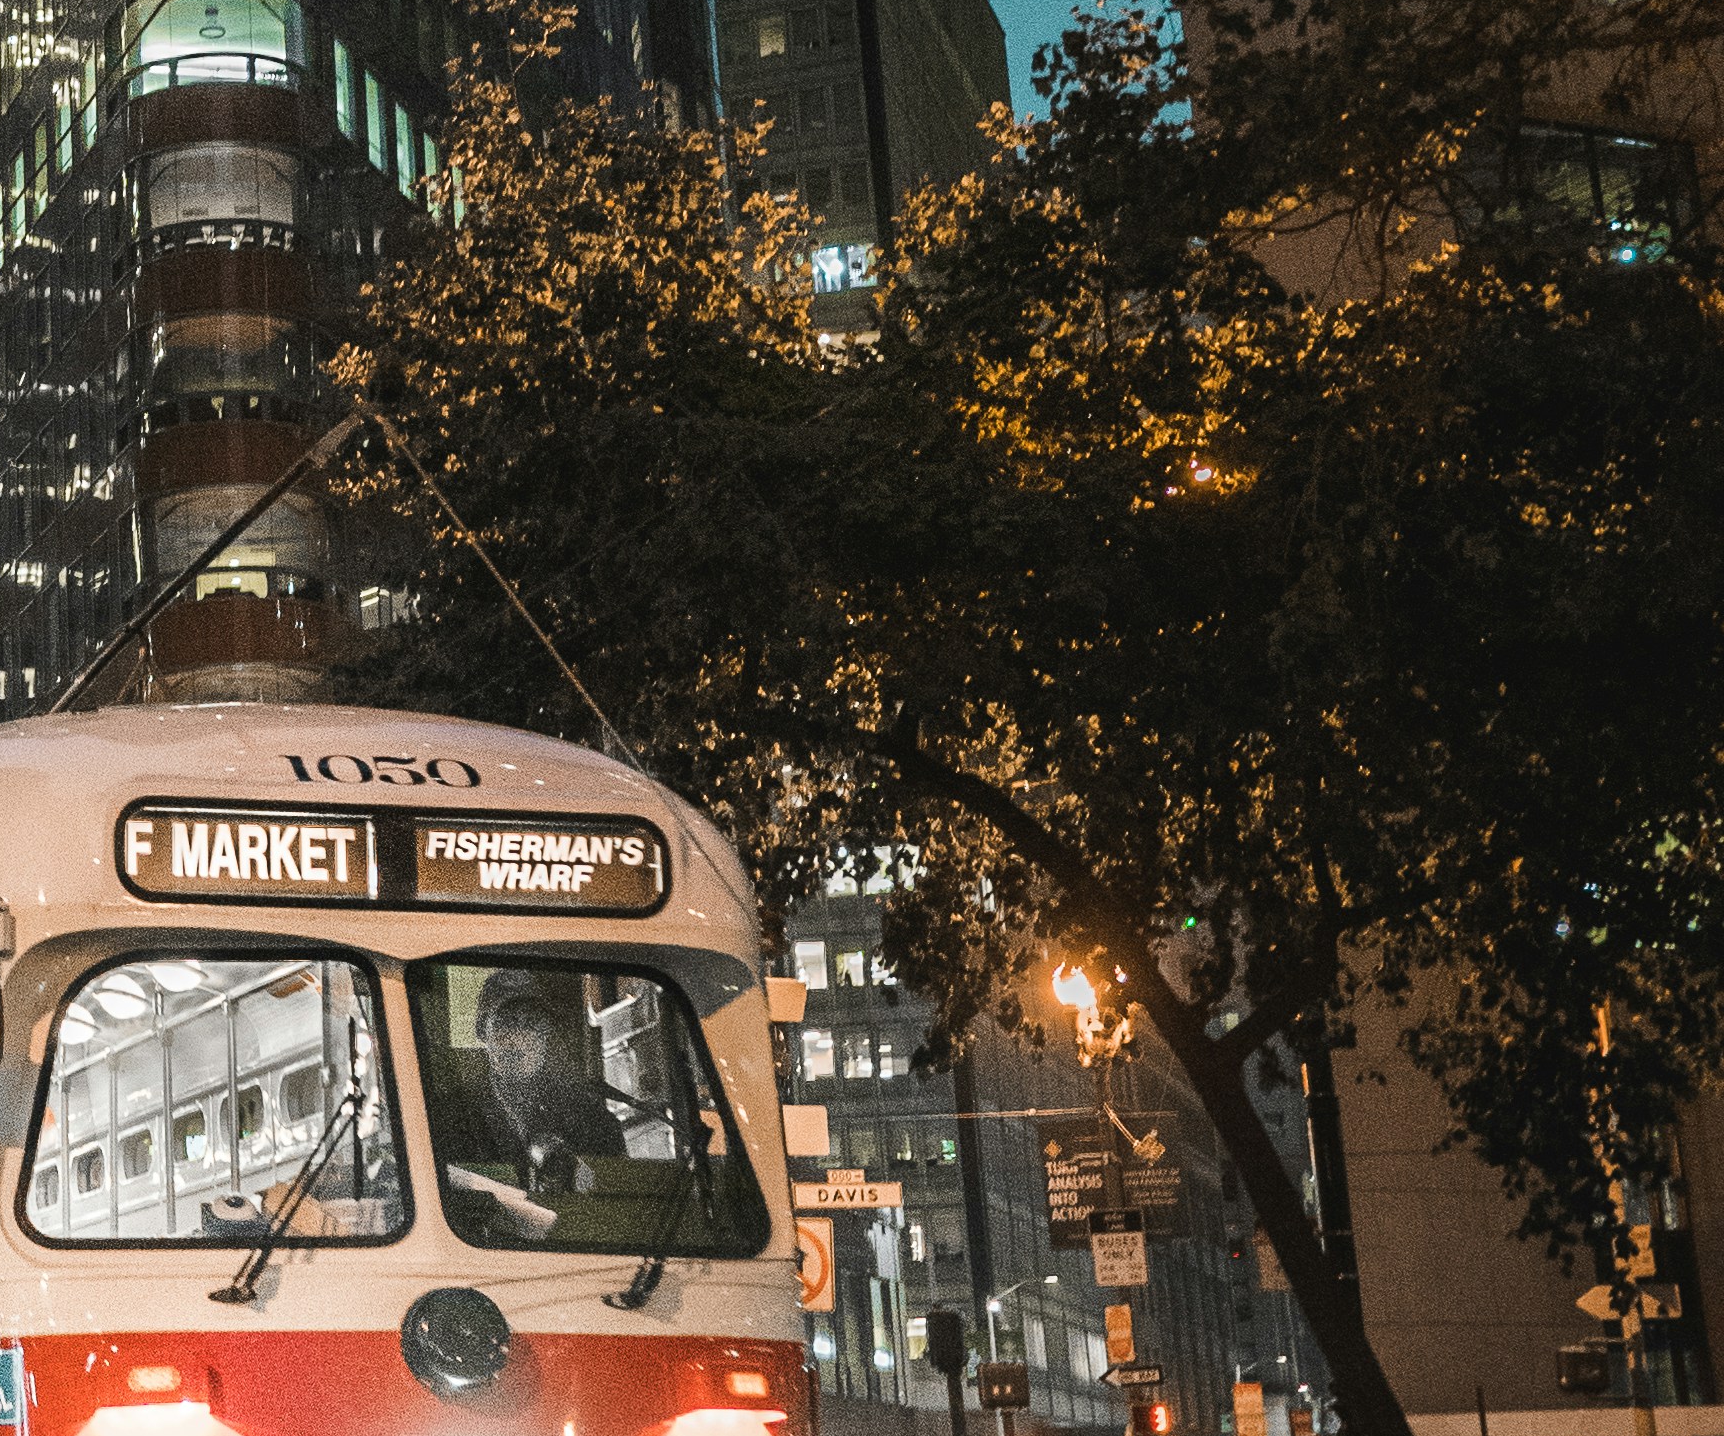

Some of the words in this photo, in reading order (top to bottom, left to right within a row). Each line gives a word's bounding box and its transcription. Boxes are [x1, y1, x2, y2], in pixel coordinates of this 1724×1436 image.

[279, 754, 482, 788] 1050
[125, 819, 154, 876] F
[171, 821, 356, 883] MARKET
[425, 830, 645, 867] FISHERMAN'S
[478, 861, 595, 893] WHARF
[1047, 1174, 1103, 1190] ANALYSIS
[817, 1188, 879, 1203] DAVIS
[1048, 1191, 1079, 1206] INTO
[1097, 1235, 1139, 1248] BUSES
